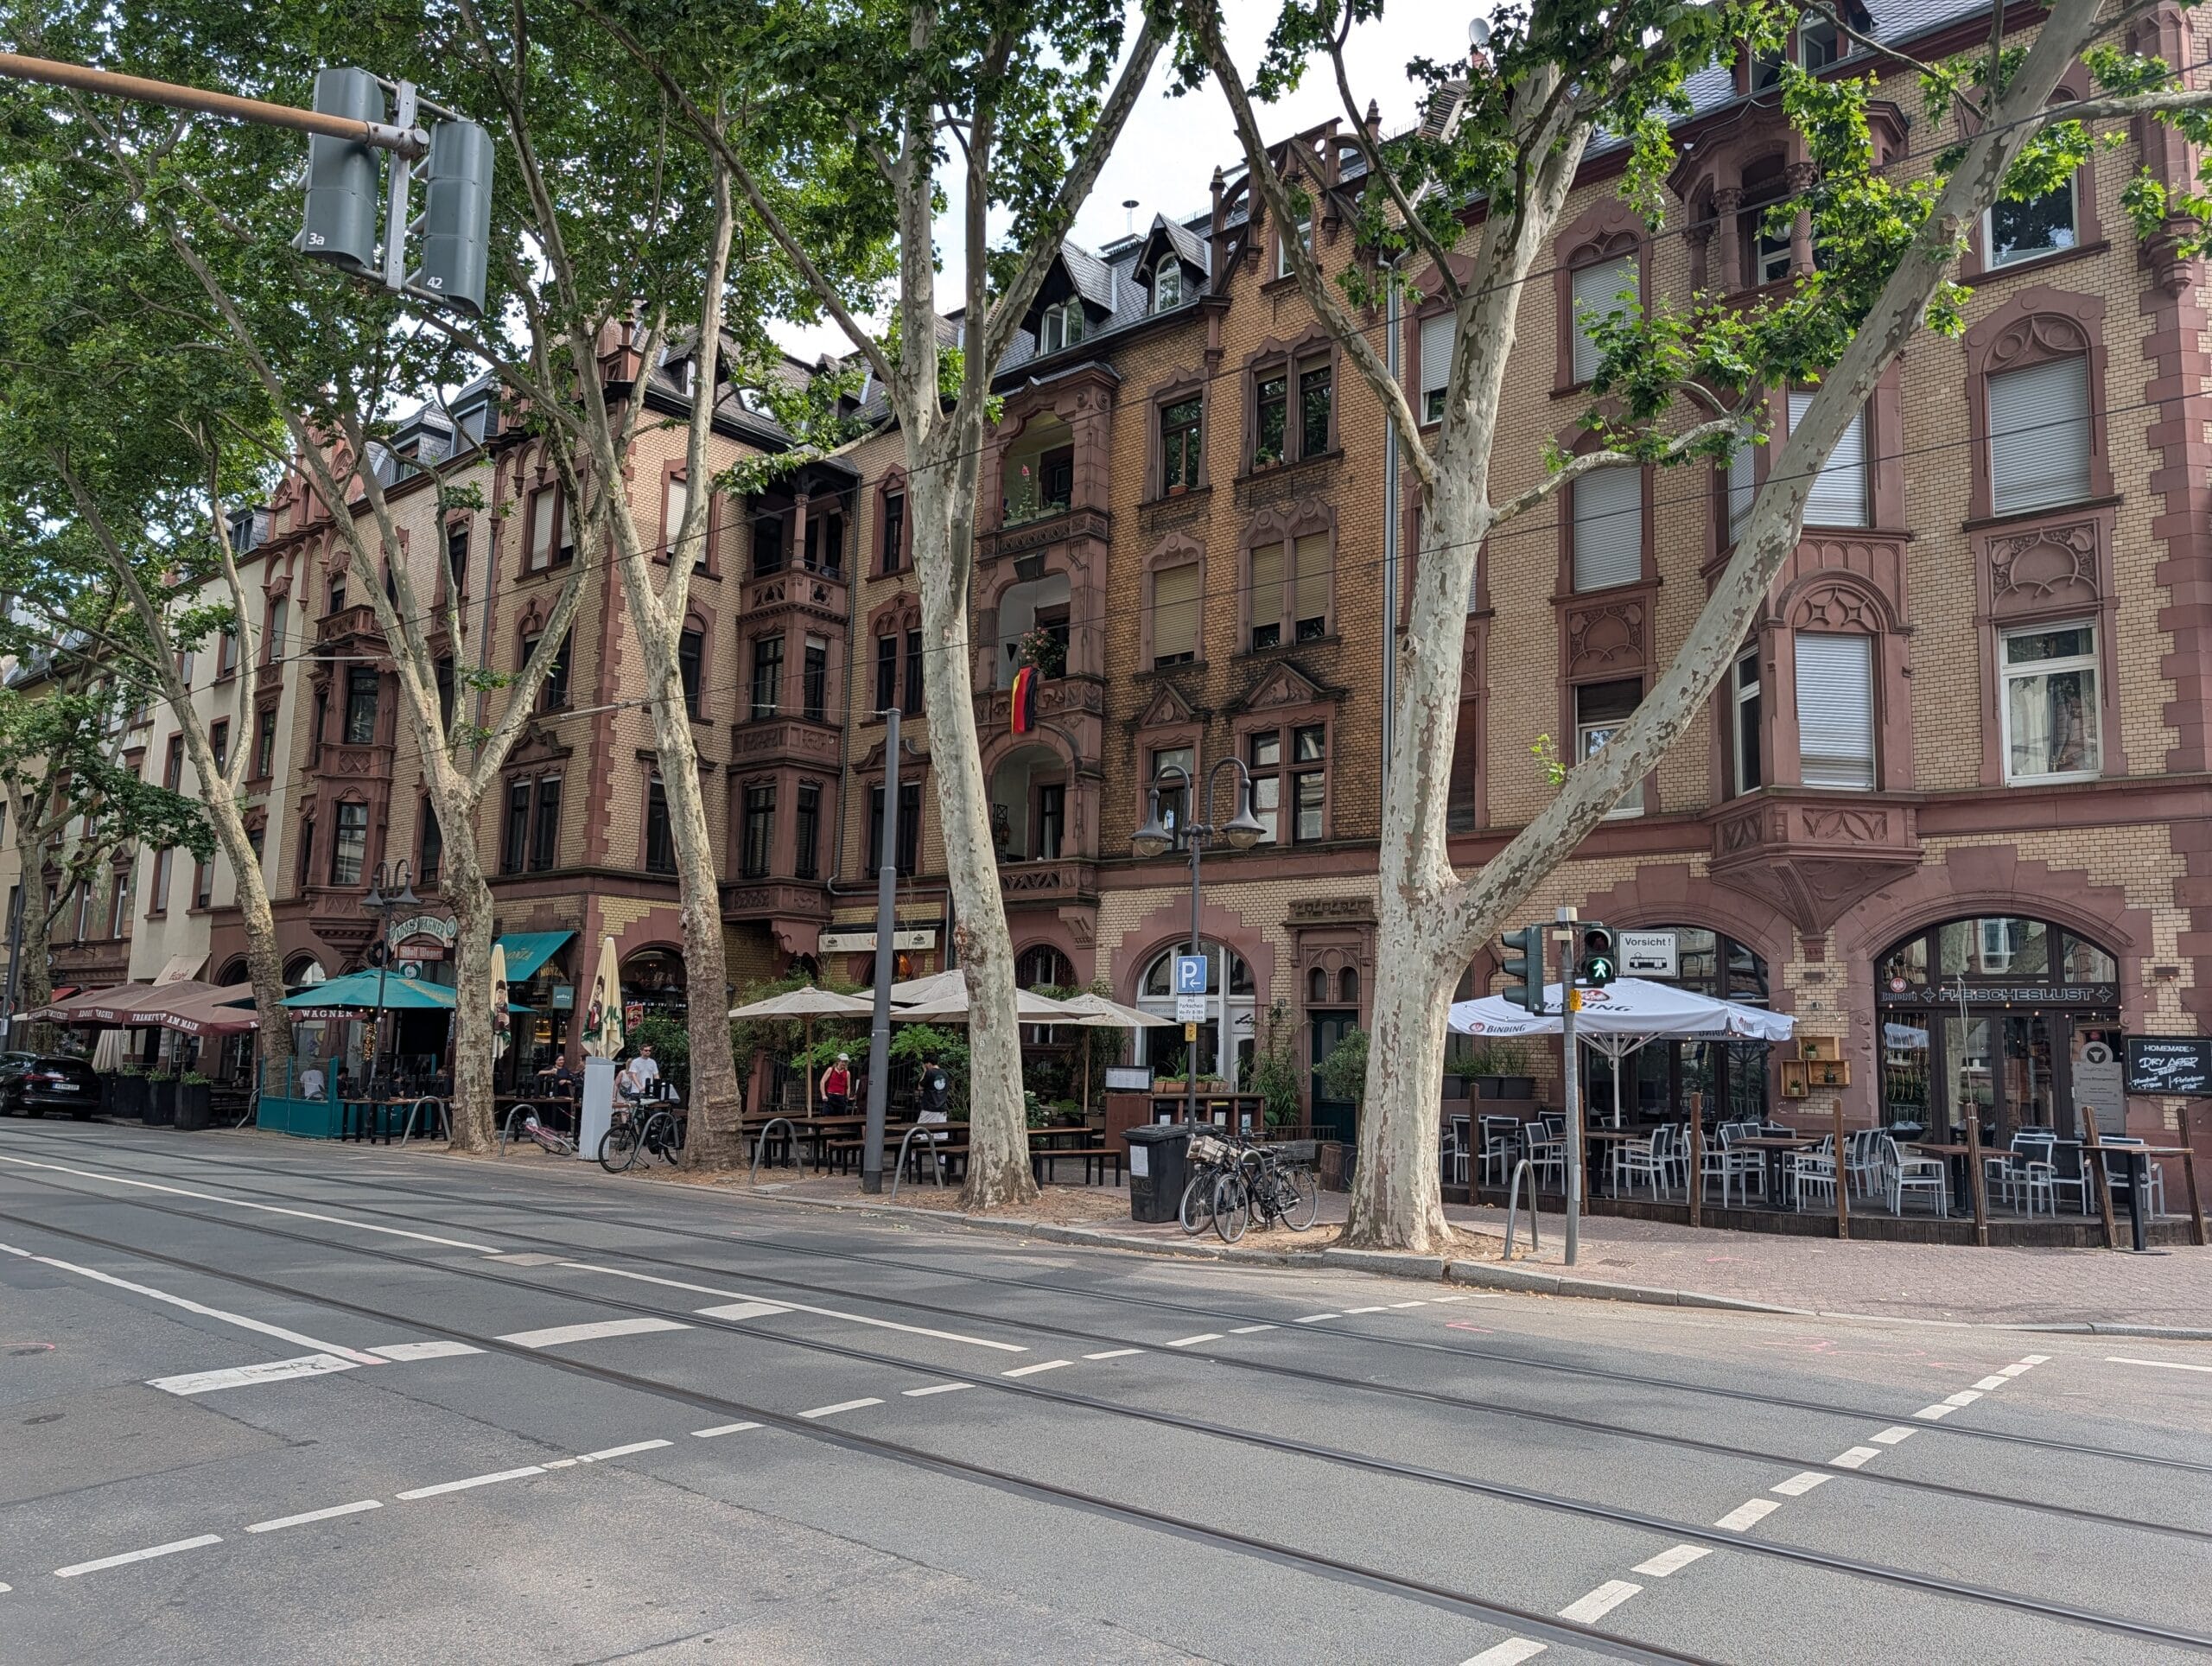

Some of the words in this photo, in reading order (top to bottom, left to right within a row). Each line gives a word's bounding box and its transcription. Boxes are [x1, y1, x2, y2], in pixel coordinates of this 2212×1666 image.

[308, 232, 325, 246] 3a
[426, 276, 443, 289] 42
[419, 917, 445, 938] WAGNER
[1624, 937, 1666, 947] Vorsicht
[1181, 961, 1198, 989] P
[1881, 991, 1917, 1002] BINDING
[1938, 989, 2094, 1002] FLEISCHESLUST
[302, 1009, 353, 1019] WAGNER
[180, 1019, 198, 1031] MAIN
[1486, 1023, 1527, 1033] BINDING
